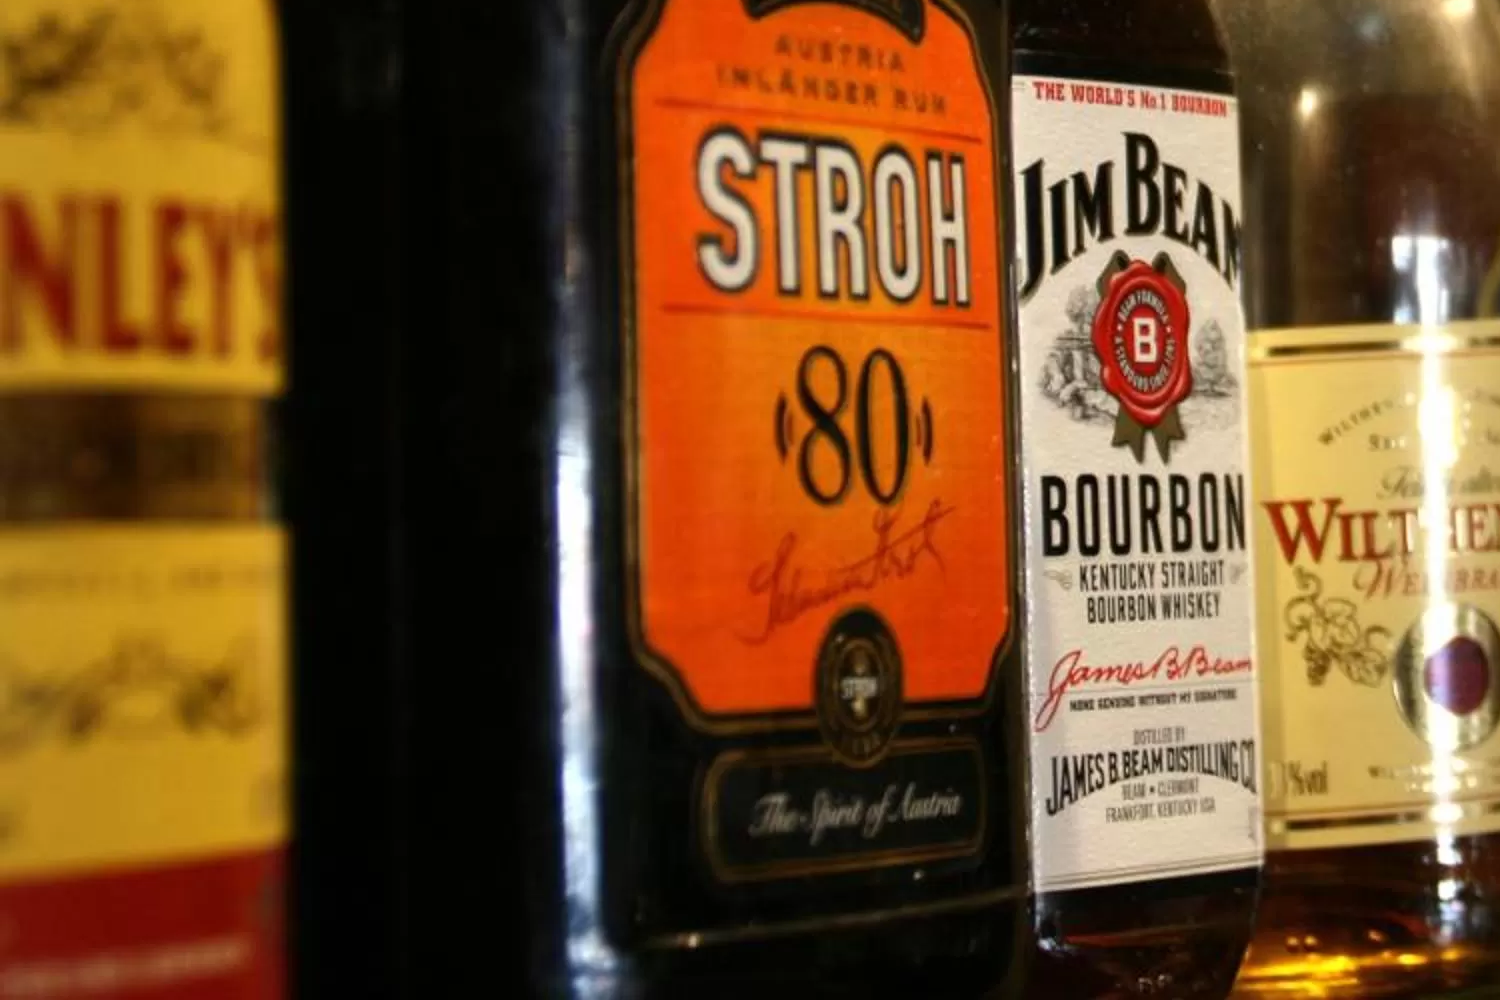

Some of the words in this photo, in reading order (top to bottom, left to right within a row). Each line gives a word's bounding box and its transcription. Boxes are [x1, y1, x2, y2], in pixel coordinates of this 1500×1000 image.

[774, 33, 906, 74] AUSTRIA
[1033, 80, 1065, 102] THE
[1071, 83, 1136, 107] WORLD'S
[1171, 92, 1227, 118] BOURBON
[697, 124, 971, 308] STROH
[1018, 156, 1118, 305] JIM
[1133, 316, 1158, 363] B
[1039, 473, 1247, 558] BOURBON
[1078, 562, 1156, 593] KENTUCKY
[1160, 559, 1225, 590] STRAIGHT
[1086, 595, 1157, 625] BOURBON
[1160, 591, 1222, 620] WHISKEY
[1035, 649, 1150, 734] James
[1045, 751, 1106, 816] JAMES
[1121, 747, 1164, 780] BEAM
[1166, 741, 1239, 783] DISTILLING
